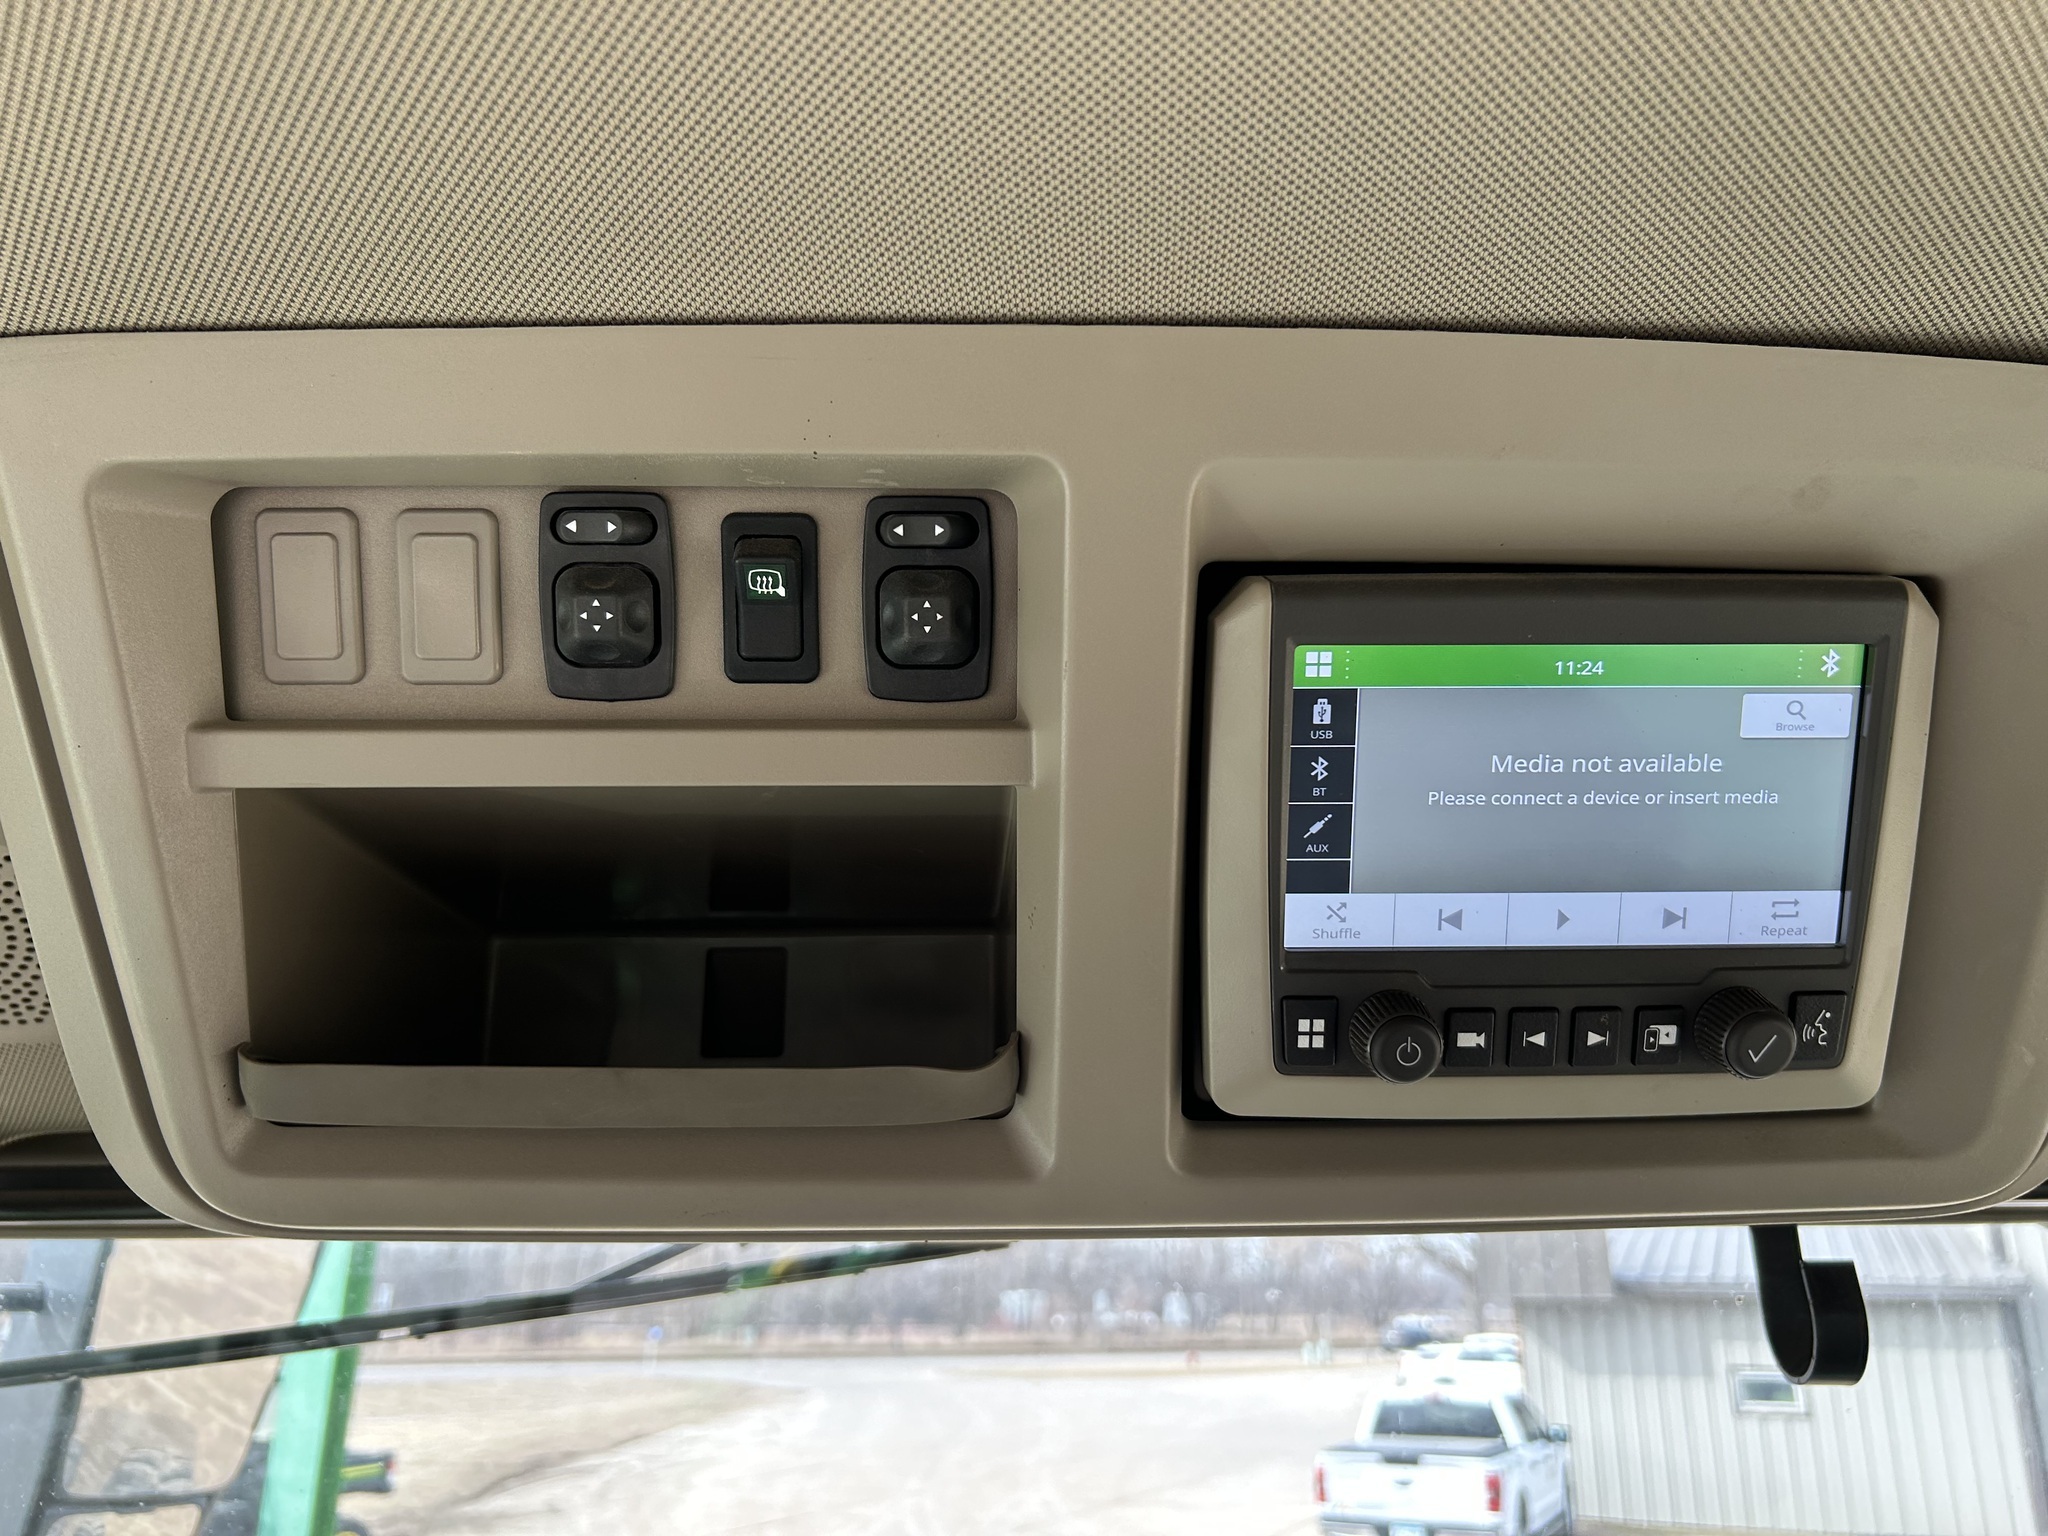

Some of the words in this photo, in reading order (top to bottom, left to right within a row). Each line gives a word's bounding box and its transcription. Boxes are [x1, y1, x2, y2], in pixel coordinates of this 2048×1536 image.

[1554, 660, 1604, 676] 11:24
[1776, 722, 1815, 732] Browse
[1310, 729, 1334, 740] USB
[1491, 753, 1564, 773] Media
[1572, 756, 1612, 773] not
[1618, 753, 1723, 773] available
[1312, 786, 1327, 797] BT
[1428, 790, 1486, 806] Please
[1491, 791, 1563, 805] connect
[1567, 794, 1577, 805] a
[1583, 790, 1640, 805] device
[1645, 793, 1665, 805] or
[1669, 789, 1719, 805] insert
[1724, 788, 1779, 804] media
[1306, 842, 1329, 853] AUX
[1312, 927, 1361, 940] Shuffle
[1760, 925, 1808, 938] Repeat
